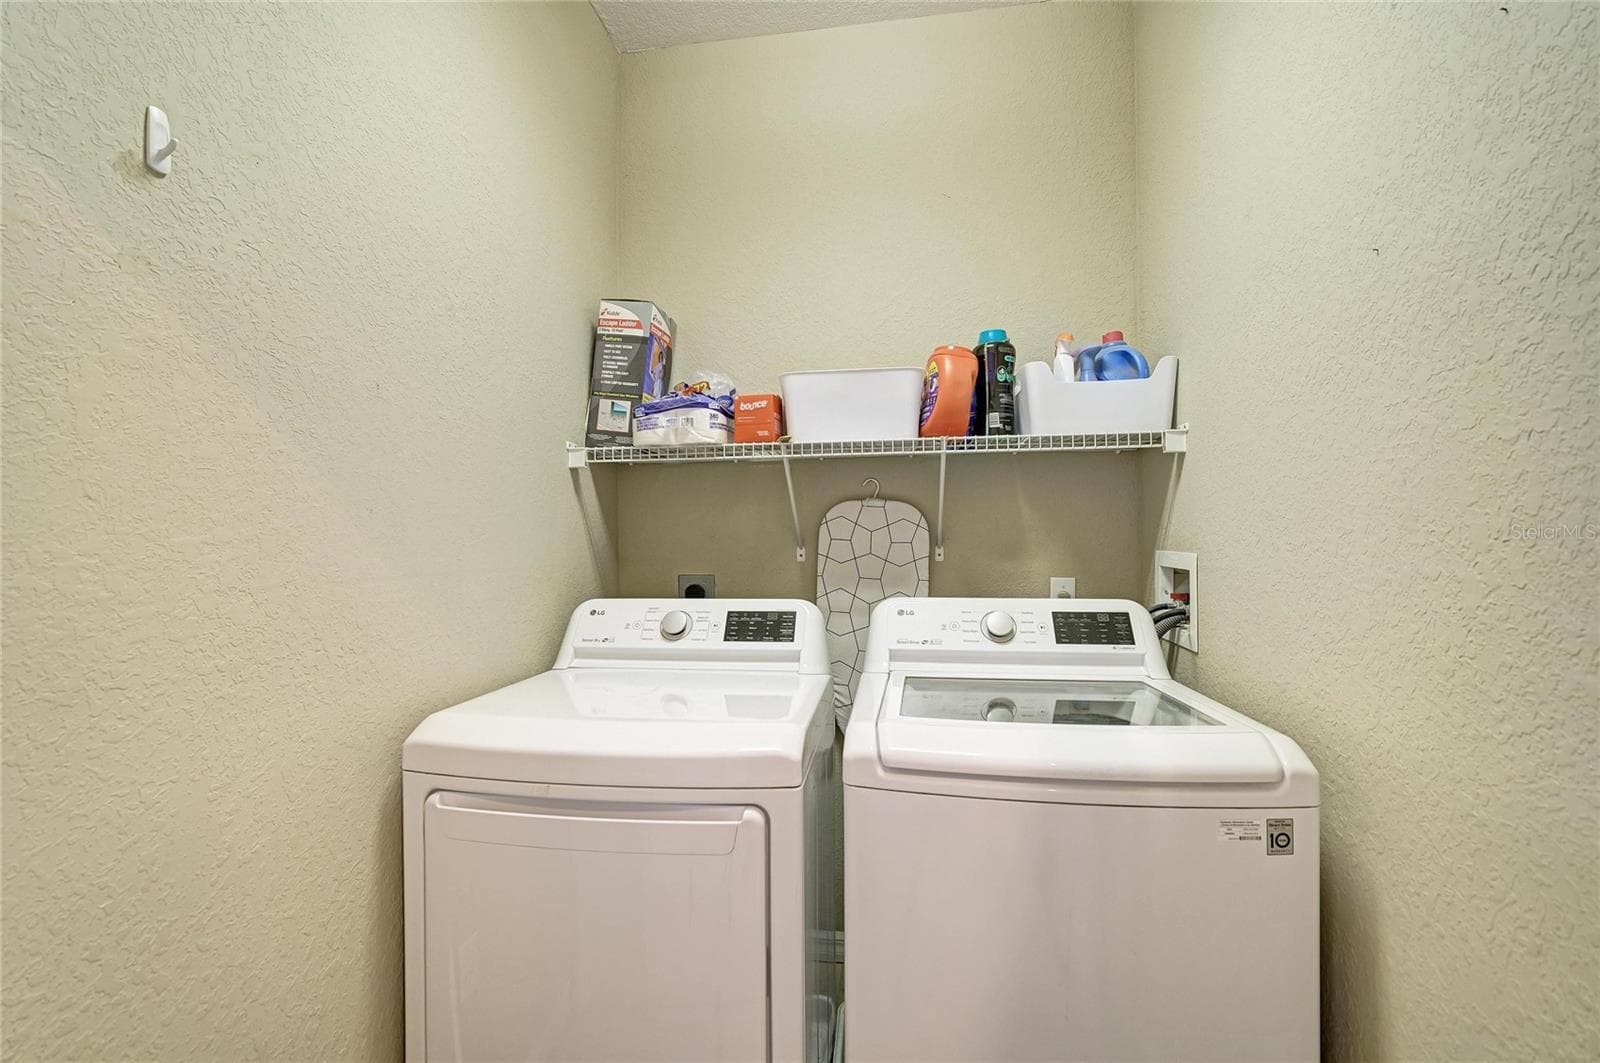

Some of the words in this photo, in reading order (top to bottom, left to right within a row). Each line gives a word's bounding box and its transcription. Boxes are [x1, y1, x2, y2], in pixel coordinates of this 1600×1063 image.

[599, 318, 619, 327] Escape
[619, 320, 637, 328] Ladder
[740, 400, 768, 411] bounce
[1270, 832, 1291, 848] 10
